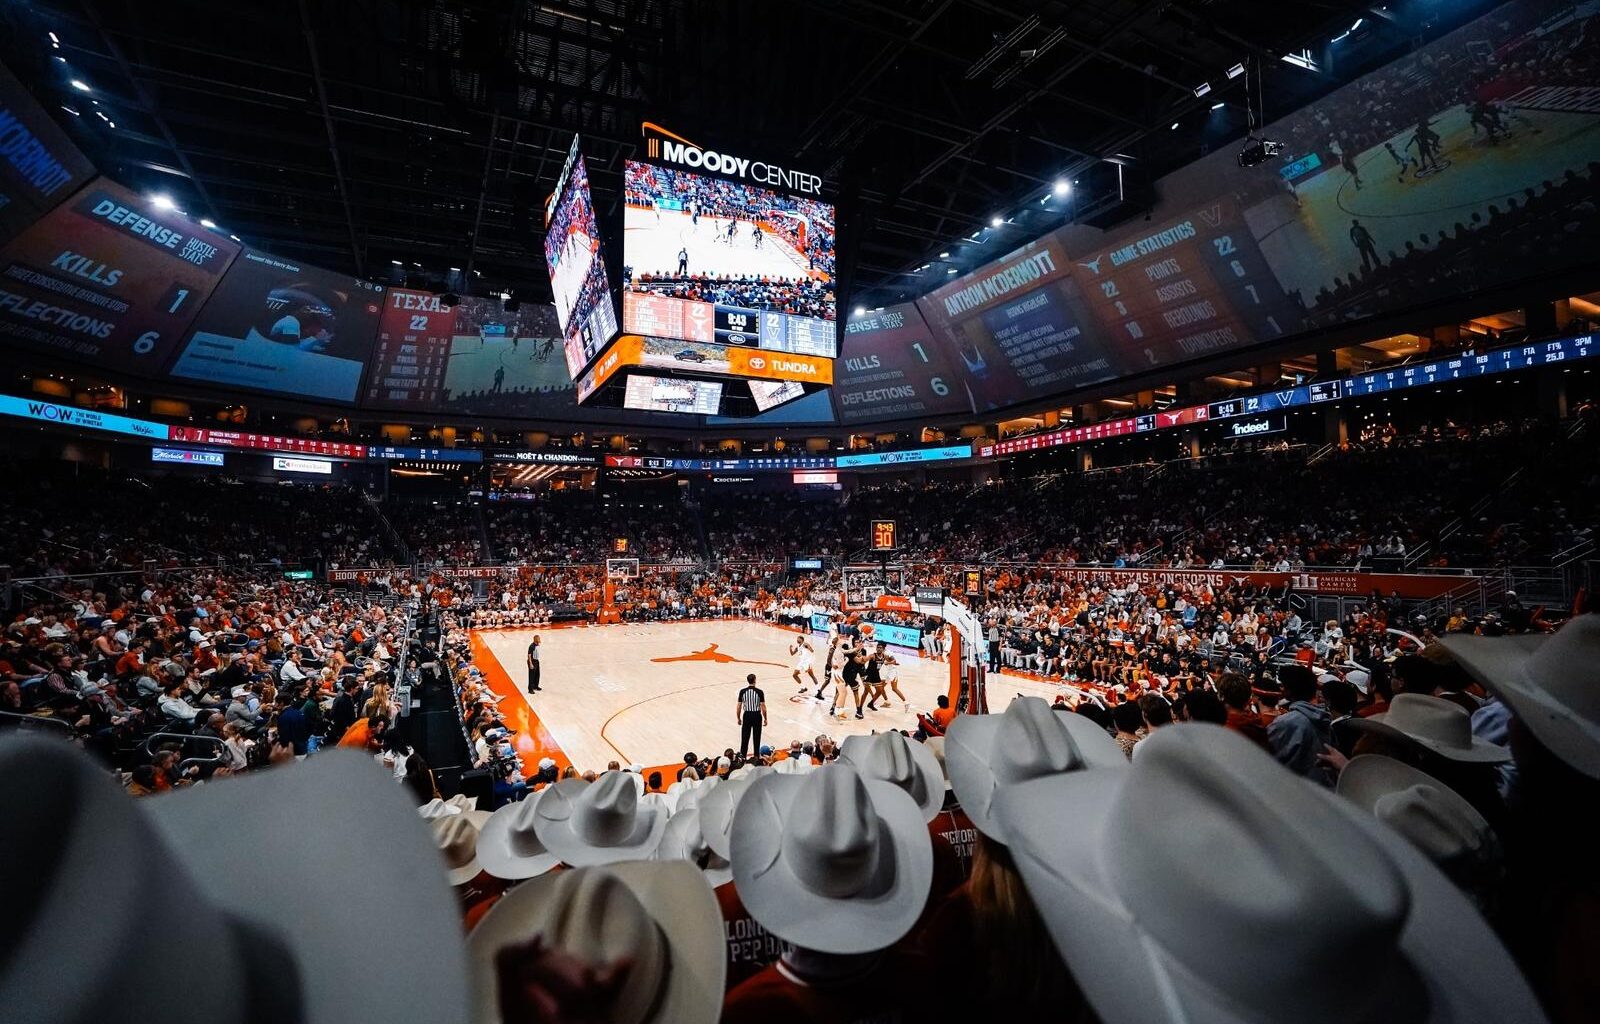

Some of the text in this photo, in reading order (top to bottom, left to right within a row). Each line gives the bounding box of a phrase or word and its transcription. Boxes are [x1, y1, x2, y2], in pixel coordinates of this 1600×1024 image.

[664, 141, 822, 194] MOODY CENTER
[92, 200, 183, 249] DEFENSE
[187, 236, 218, 259] HUSTLE
[1110, 221, 1197, 267] GAME STATISTICS
[1213, 235, 1237, 257] 22
[179, 249, 206, 265] STATS
[50, 250, 124, 287] KILLS
[982, 249, 1056, 299] MCDERMOTT
[1145, 258, 1181, 281] POINTS
[1230, 260, 1246, 278] 6
[1101, 281, 1120, 298] 22
[1156, 279, 1197, 304] ASSISTS
[1245, 285, 1260, 304] 7
[169, 289, 189, 315] 1
[691, 303, 705, 317] 22
[1163, 300, 1217, 329] REBOUNDS
[409, 315, 428, 331] 22
[767, 314, 779, 327] 22
[881, 320, 904, 330] STATS
[1267, 315, 1282, 334] 1
[133, 331, 160, 354] 6
[1176, 326, 1238, 354] TURNOVERS
[1547, 342, 1562, 351] FT%
[1574, 336, 1592, 346] 3PM
[912, 342, 928, 363] 1
[1144, 348, 1158, 365] 2
[1503, 351, 1511, 360] FT
[1523, 347, 1536, 356] FTA
[1545, 351, 1565, 362] 25.0
[1580, 348, 1587, 356] 5
[845, 355, 881, 372] KILLS
[1476, 355, 1488, 364] REB
[1505, 361, 1510, 369] 1
[1526, 357, 1532, 365] 4
[771, 360, 816, 375] TUNDRA
[1404, 369, 1414, 377] AST
[1453, 370, 1459, 378] 4
[1480, 365, 1485, 374] 7
[930, 377, 949, 396] 6
[1365, 376, 1375, 384] BLK
[841, 385, 916, 406] DEFLECTIONS
[1348, 388, 1352, 396] 1
[1248, 398, 1258, 409] 22
[28, 403, 72, 421] WOW
[1196, 407, 1206, 418] 22
[1232, 420, 1269, 435] indeed
[197, 430, 203, 441] 7
[192, 454, 223, 463] ULTRA
[880, 453, 904, 462] WOW
[875, 532, 892, 547] 30
[335, 571, 359, 581] HOOK
[485, 569, 497, 577] TO
[1077, 572, 1088, 582] OF
[1092, 573, 1112, 583] THE
[1115, 573, 1149, 585] TEXAS
[1151, 574, 1224, 589] LONGHORNS
[892, 631, 907, 642] WOW
